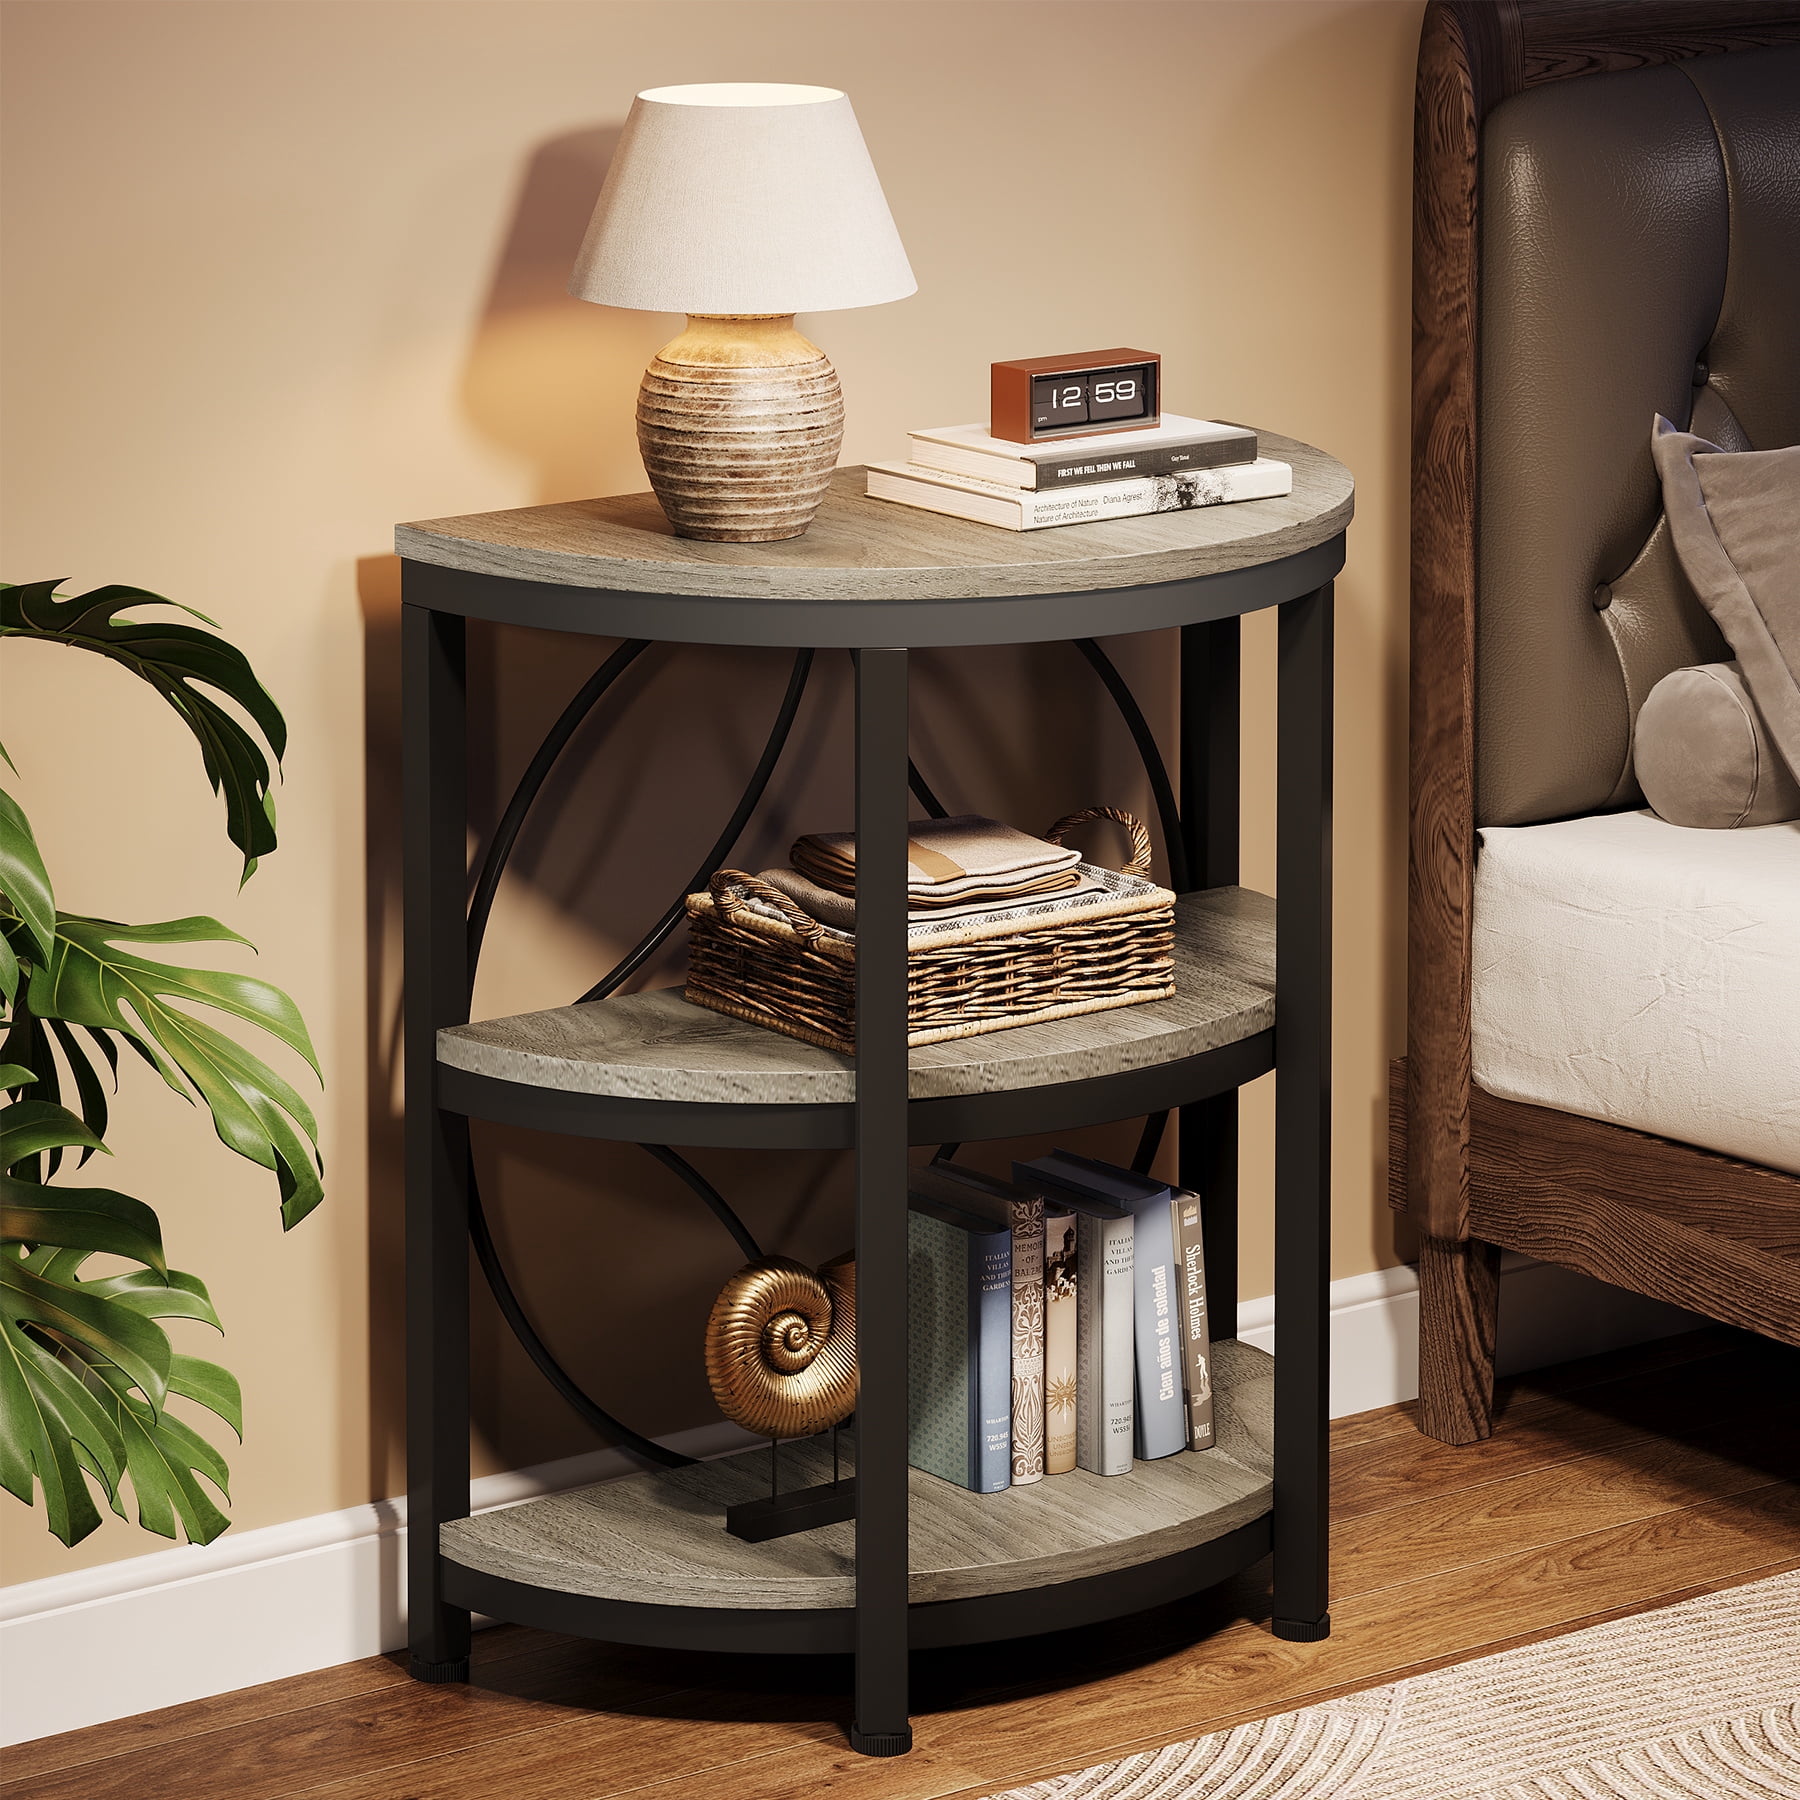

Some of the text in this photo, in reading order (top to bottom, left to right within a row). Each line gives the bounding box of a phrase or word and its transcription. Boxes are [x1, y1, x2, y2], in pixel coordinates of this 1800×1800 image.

[1052, 380, 1136, 409] 12 59
[1057, 459, 1136, 478] FIRST WE FELL THEN WE FALL
[1033, 503, 1070, 513] Architecture
[1078, 498, 1099, 508] Nature
[1102, 495, 1121, 505] Diana
[1033, 514, 1054, 524] Nature
[1062, 509, 1099, 520] Architecture
[1185, 1244, 1205, 1341] Sherlock Holmes
[1151, 1264, 1175, 1401] Cien años de soledad
